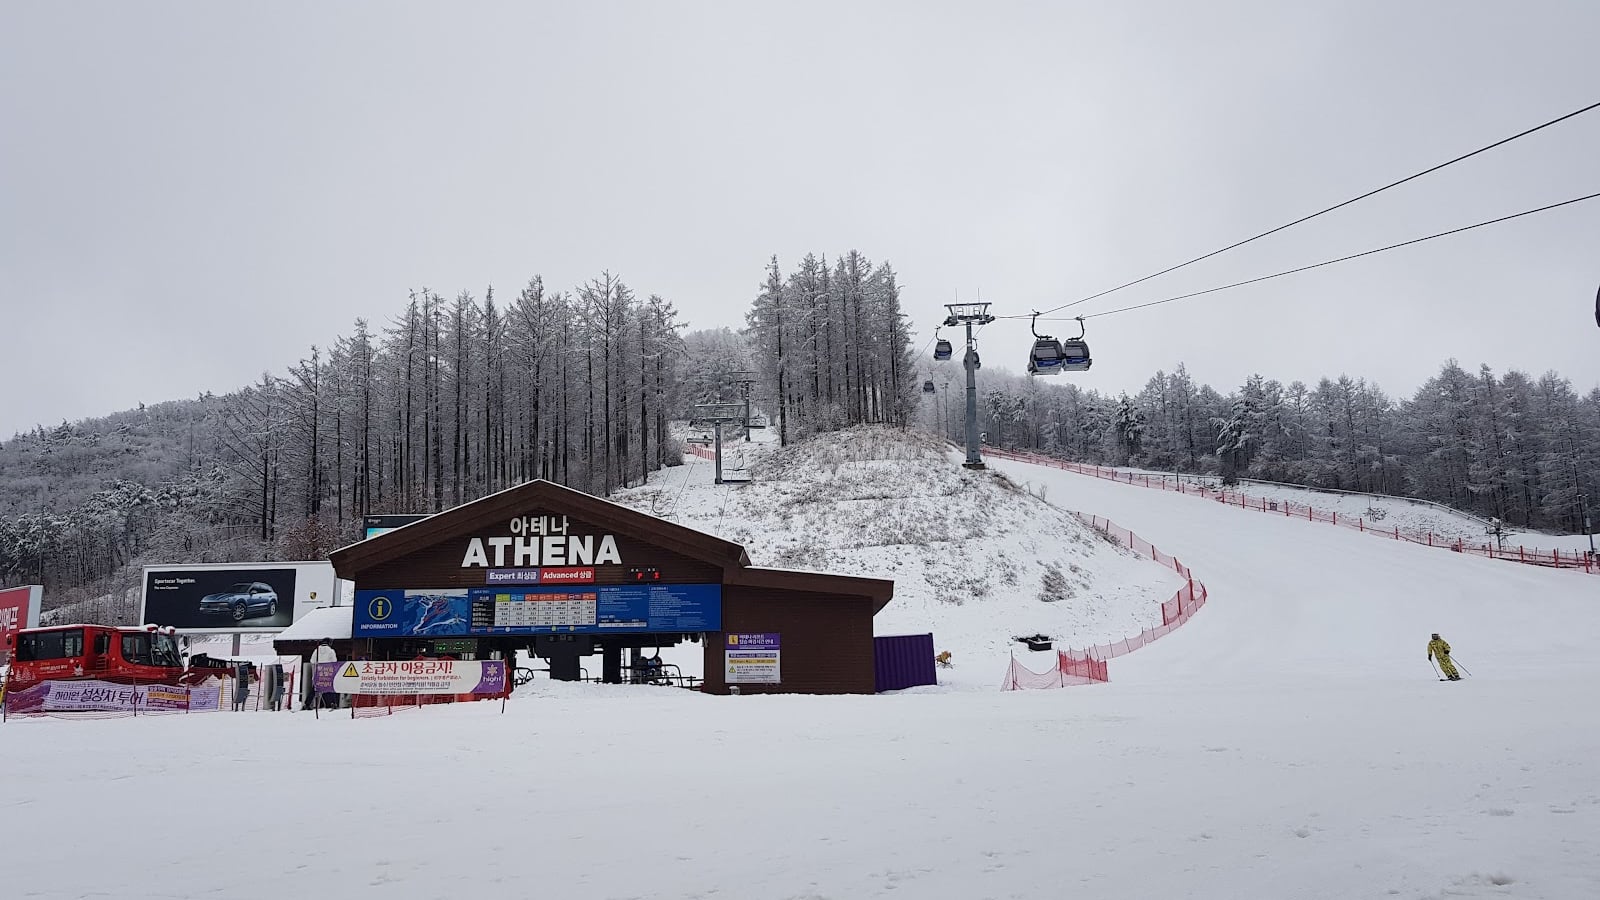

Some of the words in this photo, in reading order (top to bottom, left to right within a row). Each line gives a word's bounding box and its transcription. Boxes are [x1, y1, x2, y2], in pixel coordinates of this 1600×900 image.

[510, 515, 569, 536] 아테나
[461, 535, 622, 568] ATHENA
[489, 572, 516, 581] Expert
[543, 571, 578, 580] Advanced
[579, 570, 592, 579] 상급
[362, 662, 398, 675] 초급자
[401, 661, 453, 675] 이용금지!
[55, 691, 79, 701] 하이원
[80, 688, 117, 703] 설상차
[118, 691, 144, 704] 투어
